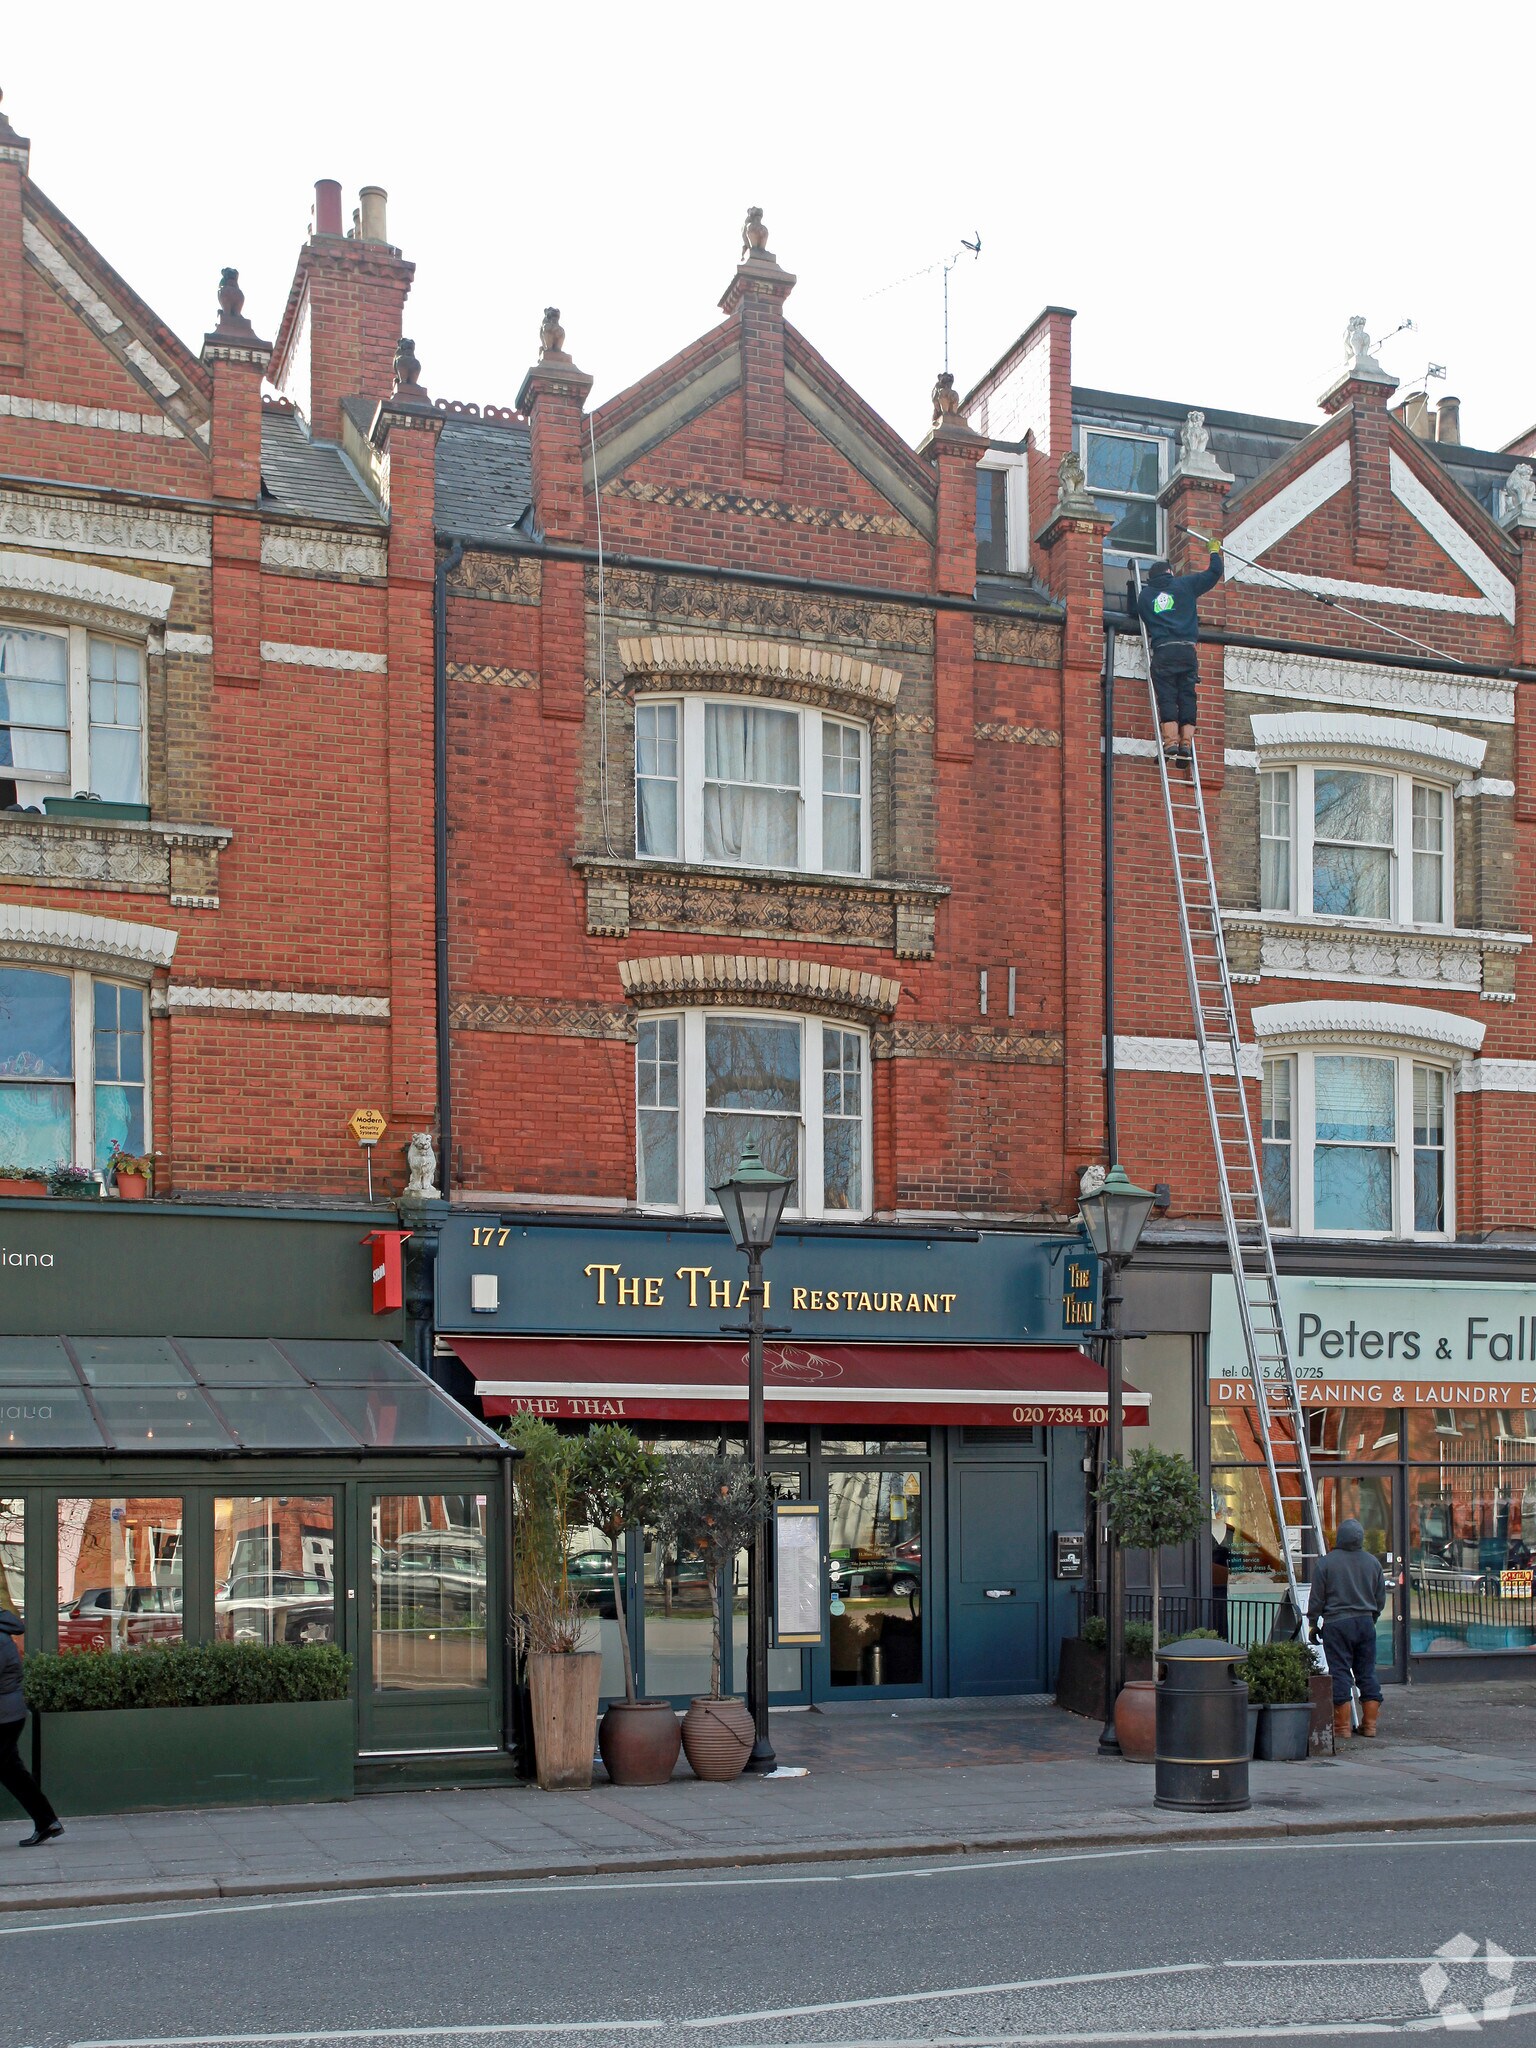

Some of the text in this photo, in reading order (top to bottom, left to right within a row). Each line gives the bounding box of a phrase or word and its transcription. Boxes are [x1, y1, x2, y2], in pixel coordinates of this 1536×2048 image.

[356, 1116, 383, 1124] Modern
[472, 1226, 511, 1247] 177
[2, 1247, 54, 1267] iana
[792, 1287, 957, 1313] RESTAURANT
[1298, 1312, 1536, 1361] Peters & Fall
[1222, 1365, 1238, 1378] tel:
[1241, 1366, 1270, 1379] 05
[1295, 1367, 1323, 1379] 0725
[1392, 1386, 1405, 1402] &
[1415, 1386, 1512, 1403] LAUNDRY
[510, 1398, 626, 1415] THE THAI
[1012, 1406, 1044, 1423] 020
[1047, 1407, 1083, 1423] 7384
